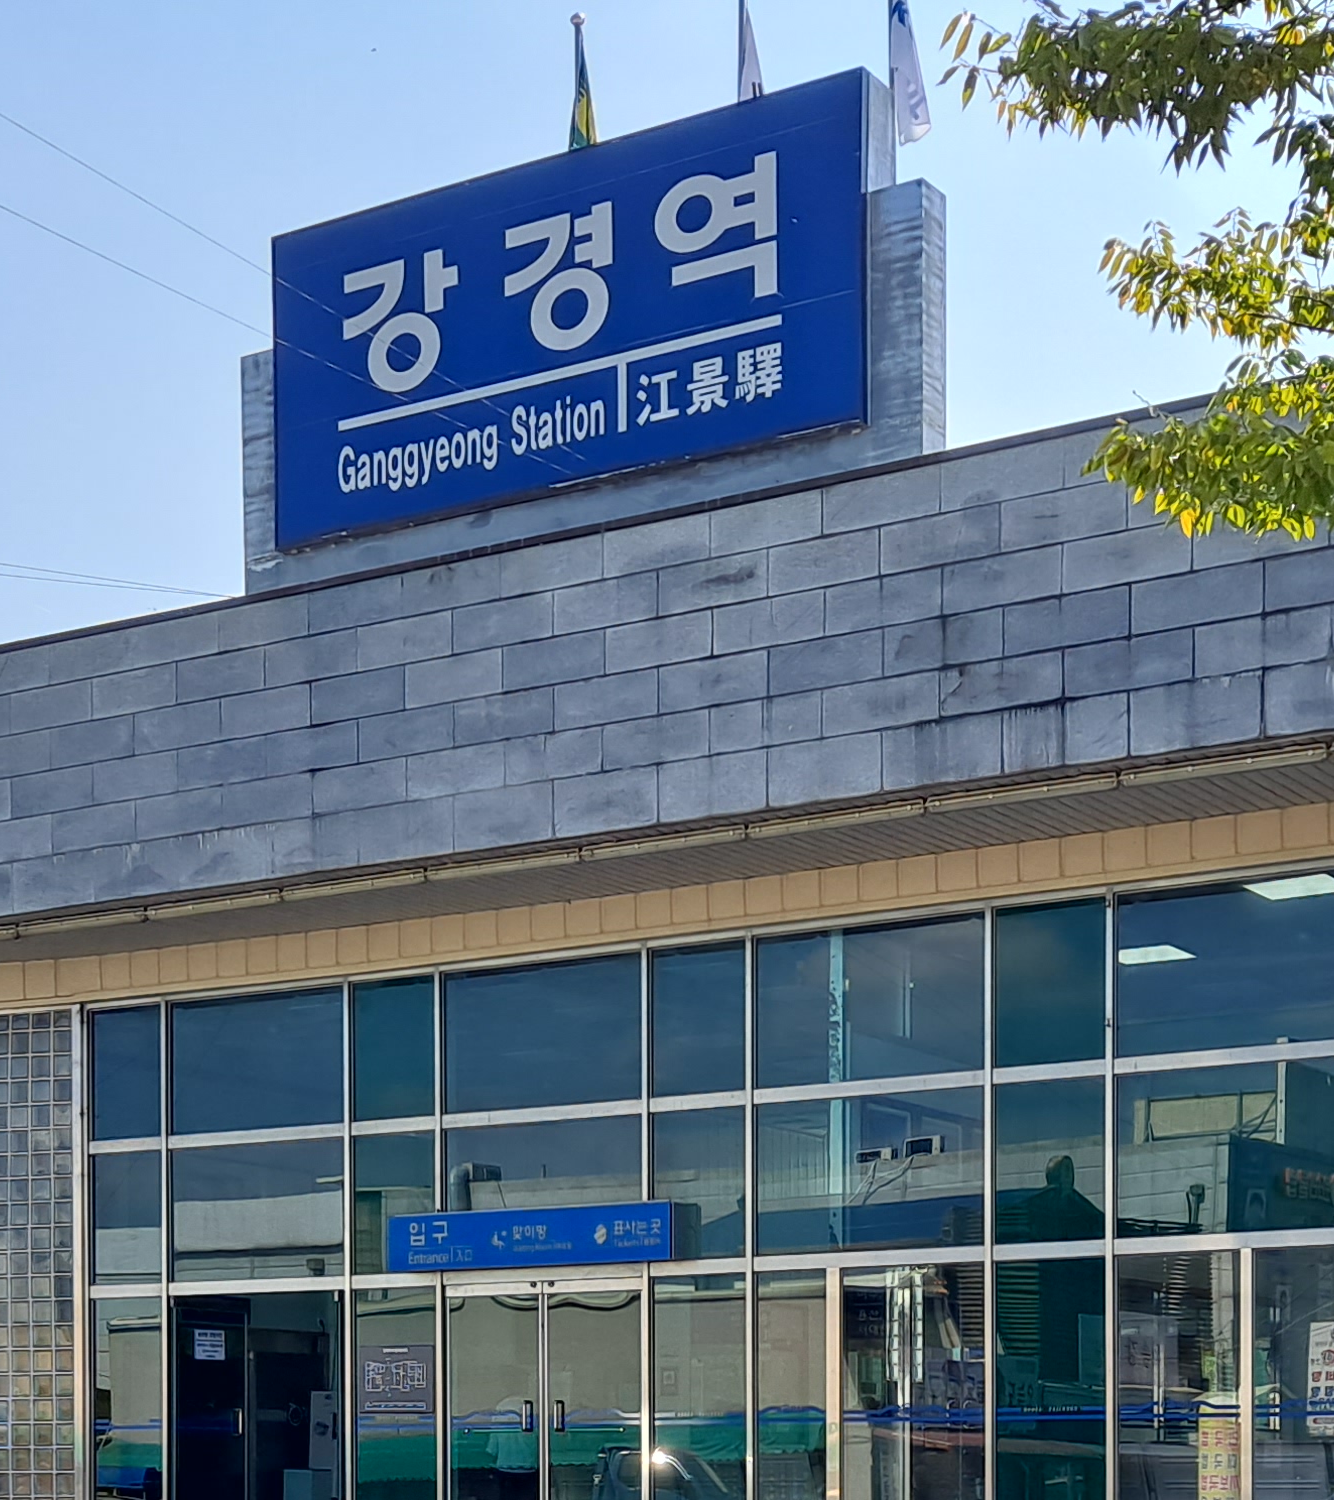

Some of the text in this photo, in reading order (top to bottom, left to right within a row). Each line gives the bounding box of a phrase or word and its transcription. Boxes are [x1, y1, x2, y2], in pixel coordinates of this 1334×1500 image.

[343, 150, 778, 393] 강경역
[635, 341, 784, 427] 江景驛
[337, 394, 606, 494] Ganggyeong Station
[409, 1221, 449, 1246] 입구
[650, 1218, 662, 1235] 곳
[408, 1251, 449, 1265] Entrance
